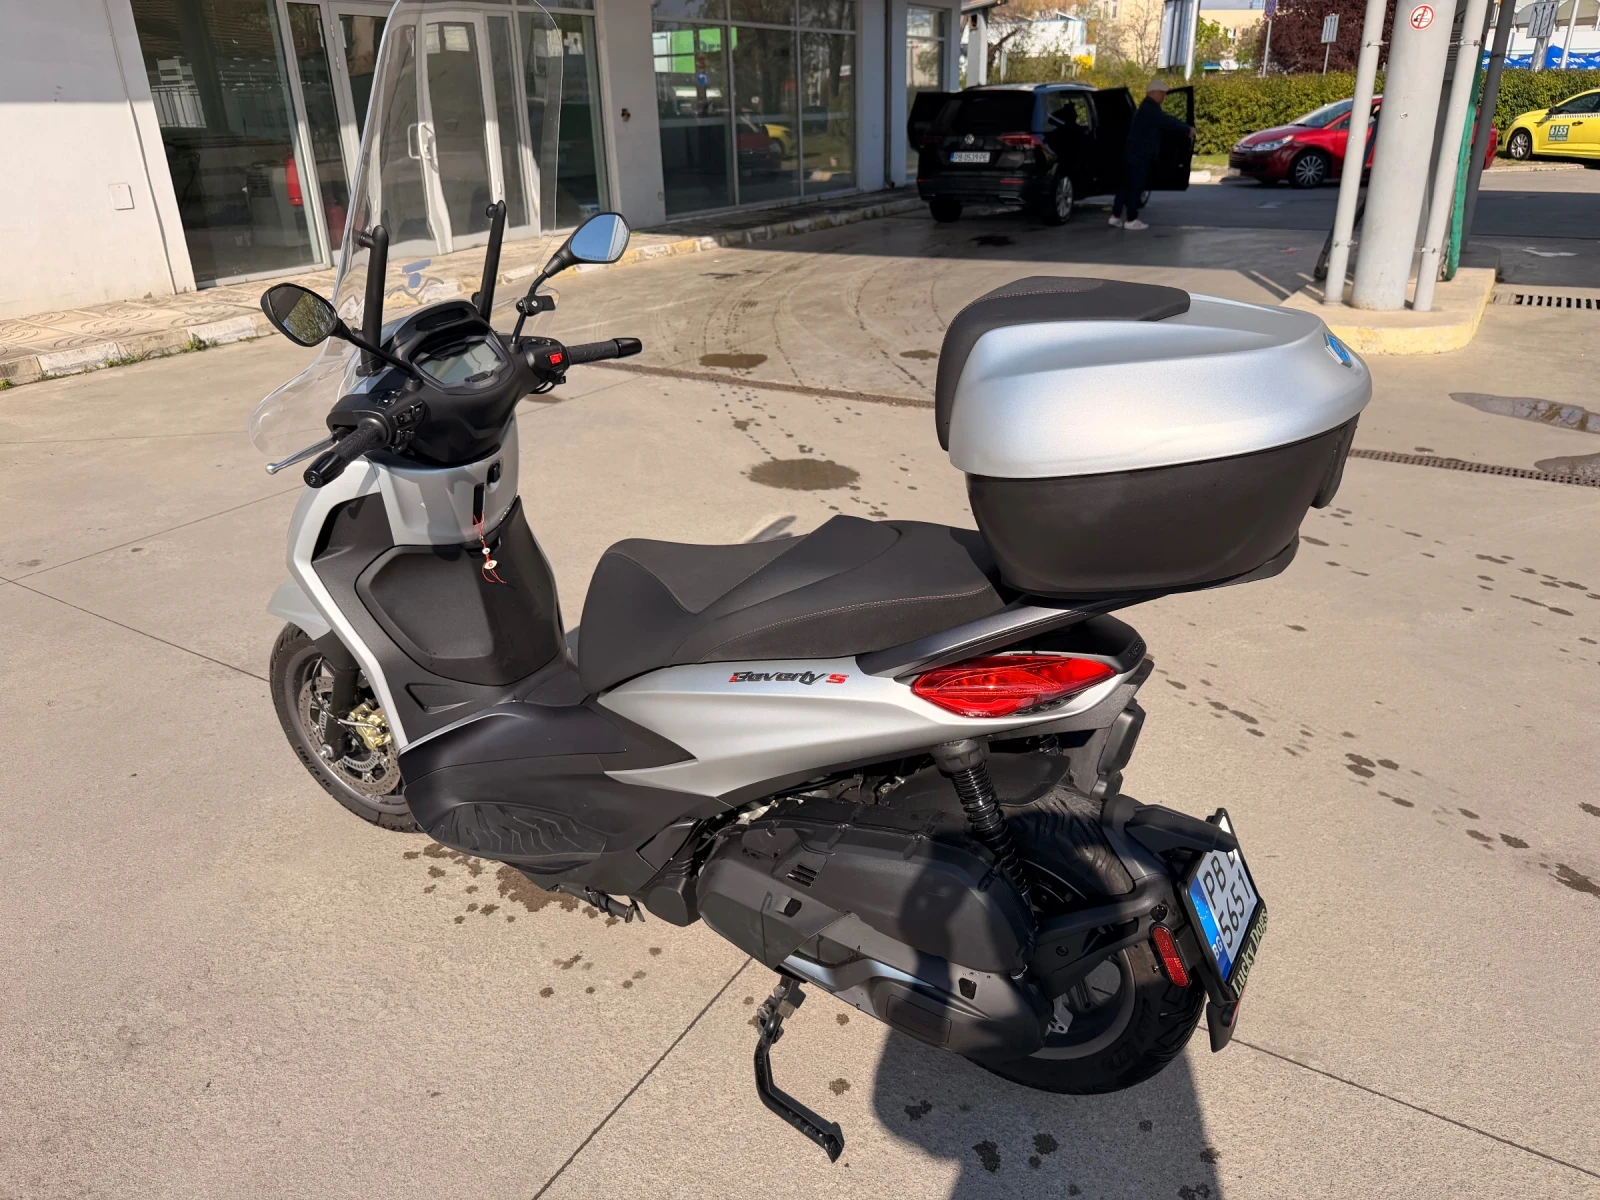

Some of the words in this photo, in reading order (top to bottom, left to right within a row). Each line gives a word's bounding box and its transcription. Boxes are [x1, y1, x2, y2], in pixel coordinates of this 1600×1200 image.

[1549, 125, 1569, 135] 6155
[728, 670, 828, 686] Beverly
[825, 673, 850, 684] S
[1203, 855, 1226, 910] PB
[1218, 869, 1251, 949] 5651
[1212, 935, 1224, 961] BG
[1231, 943, 1255, 999] Lucky
[1250, 908, 1268, 949] Dogs
